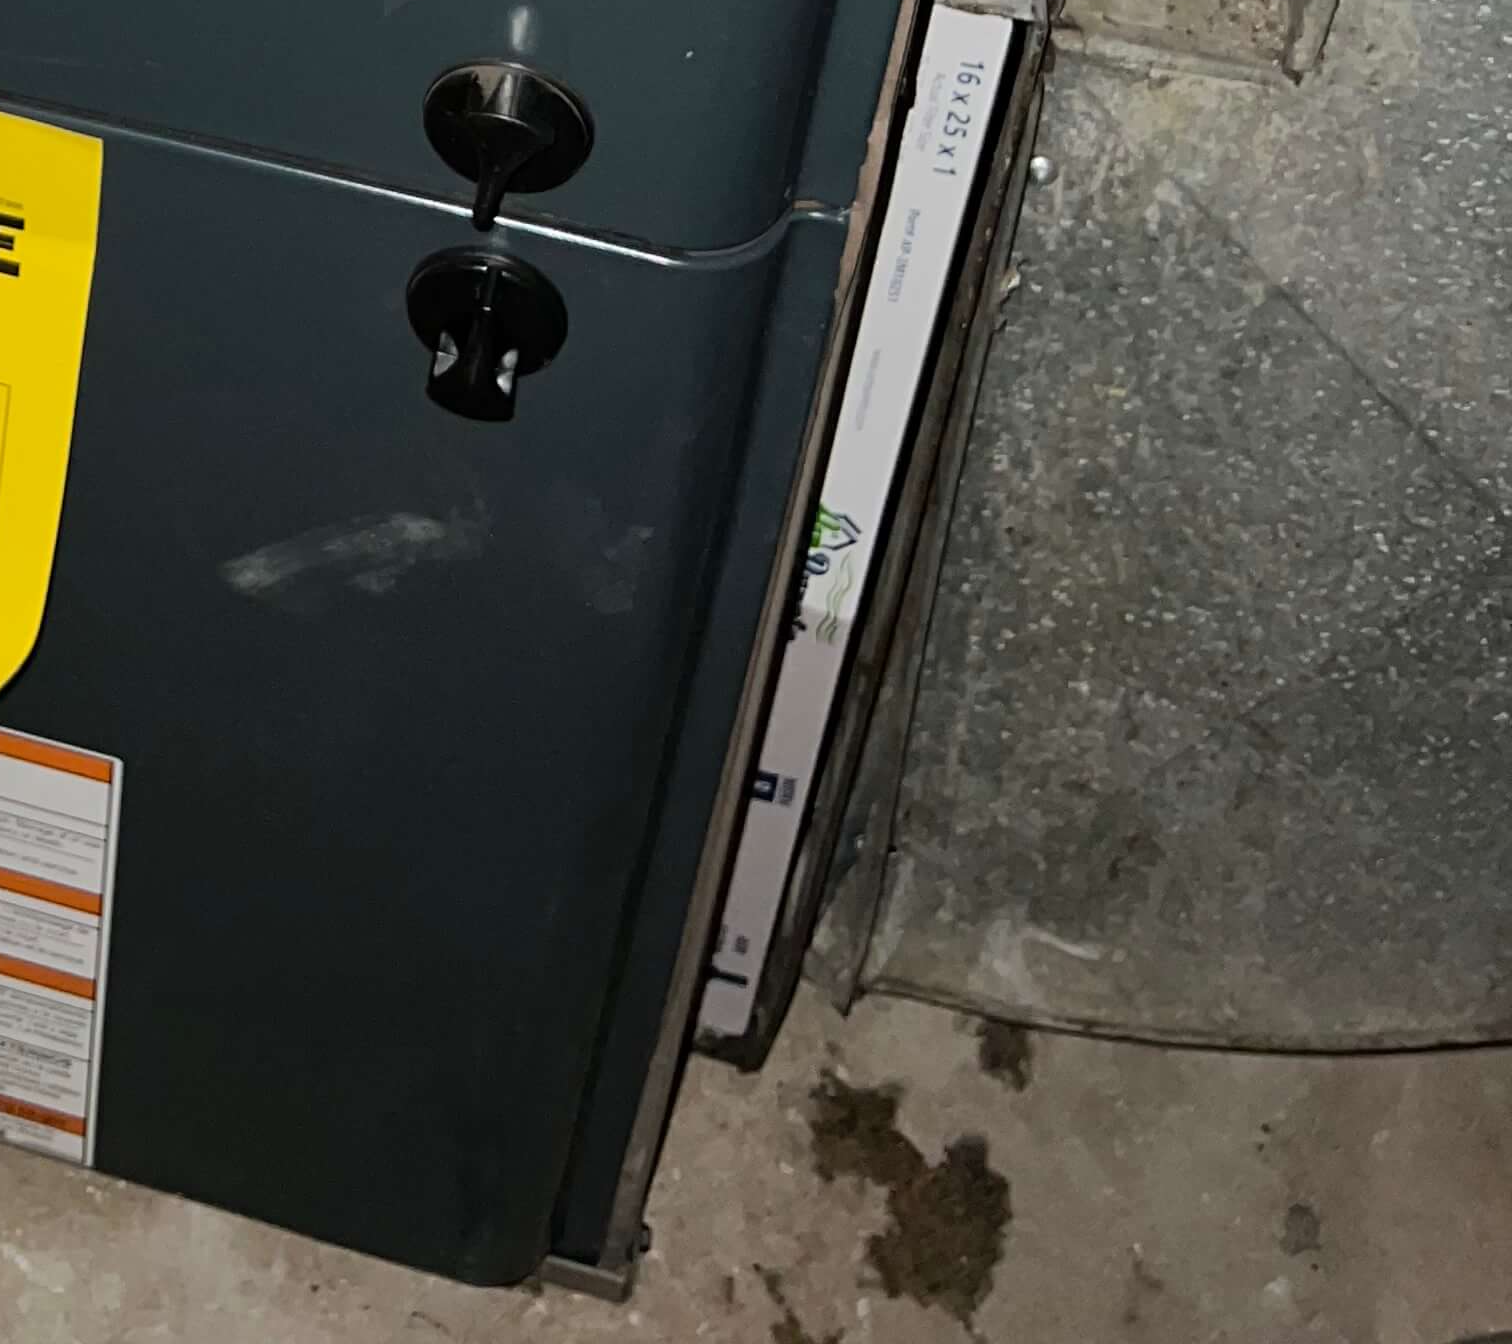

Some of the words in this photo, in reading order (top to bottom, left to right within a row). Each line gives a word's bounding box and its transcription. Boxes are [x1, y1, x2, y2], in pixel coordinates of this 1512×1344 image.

[957, 61, 984, 86] 16
[944, 112, 971, 139] 25
[932, 168, 957, 178] 1
